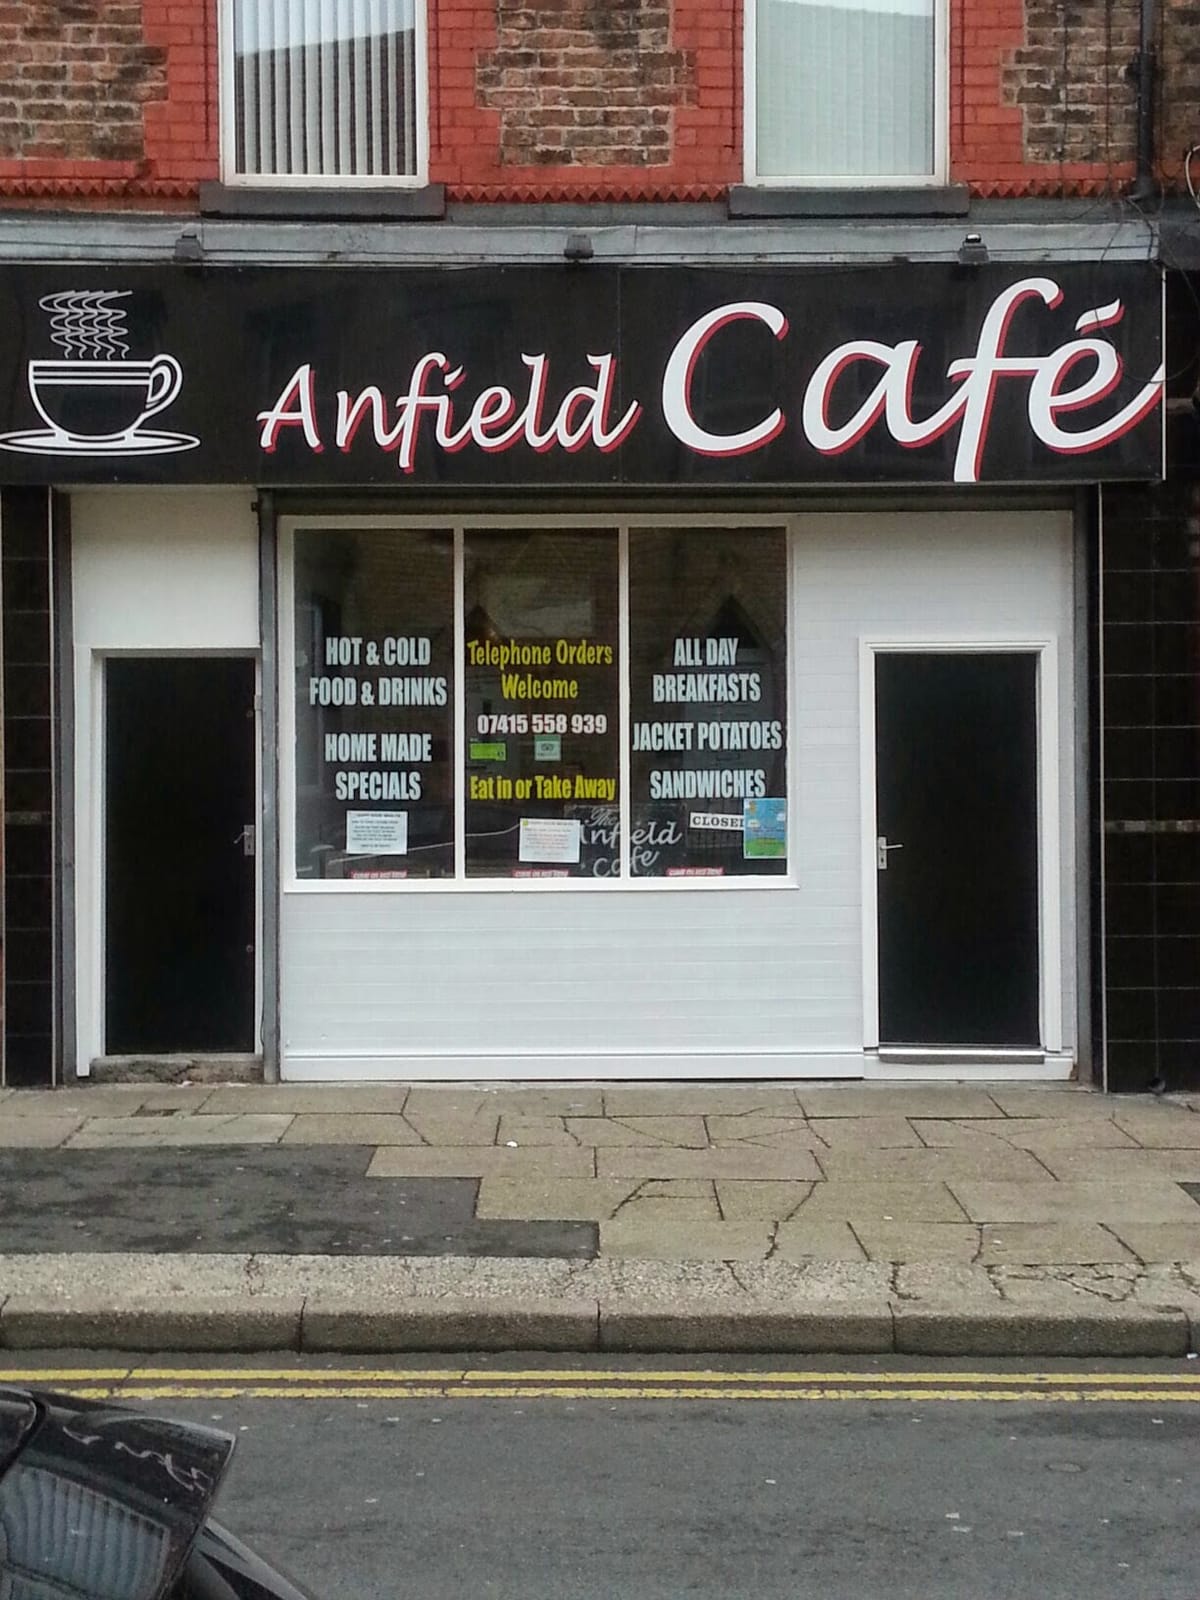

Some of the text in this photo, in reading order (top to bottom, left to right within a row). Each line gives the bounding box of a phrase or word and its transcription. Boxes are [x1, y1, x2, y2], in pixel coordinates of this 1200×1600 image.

[256, 276, 1166, 483] Anfield Café
[326, 637, 431, 666] HOT & COLD
[467, 639, 613, 670] Telephone Orders
[674, 638, 739, 666] ALL DAY
[309, 677, 448, 706] FOOD & DRINKS
[501, 673, 579, 699] Welcome
[652, 673, 761, 702] BREAKFASTS
[477, 714, 607, 734] 07415 558 939
[632, 721, 783, 751] JACKET POTATOES
[325, 733, 433, 763] HOME MADE
[335, 771, 422, 800] SPECIALS
[469, 775, 616, 801] Eat in or Take Away
[650, 769, 766, 799] SANDWICHES
